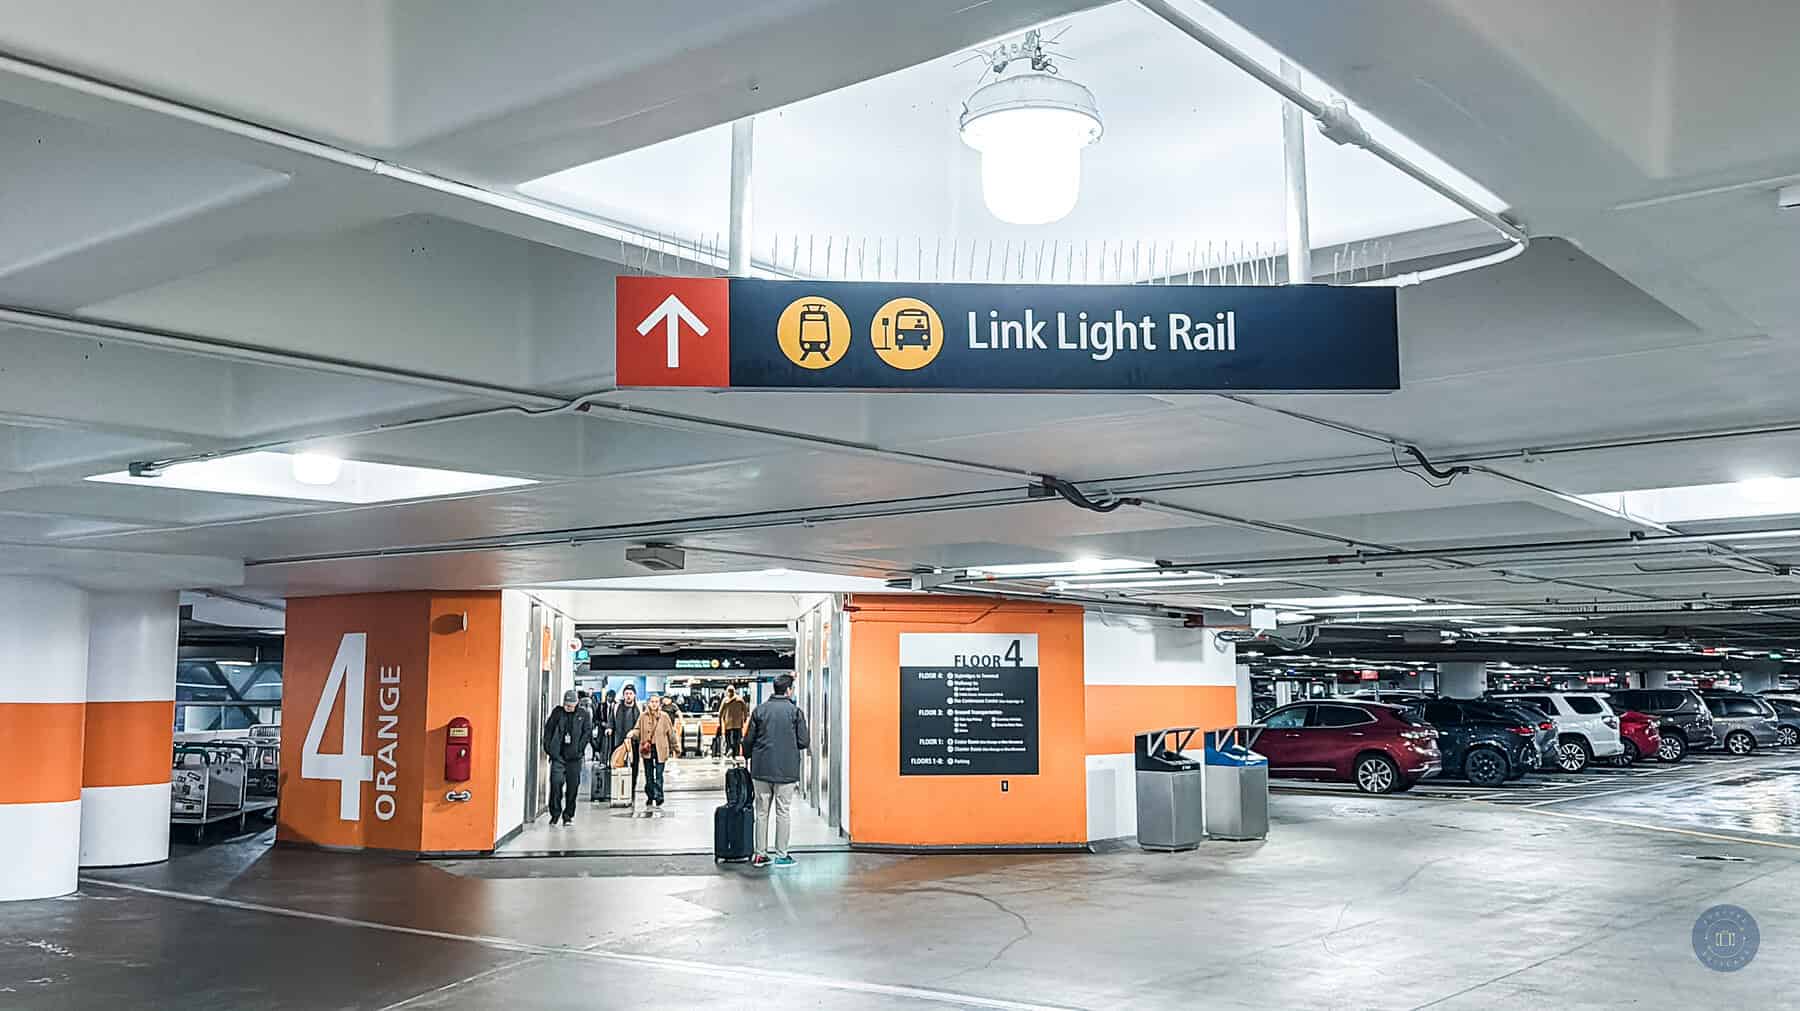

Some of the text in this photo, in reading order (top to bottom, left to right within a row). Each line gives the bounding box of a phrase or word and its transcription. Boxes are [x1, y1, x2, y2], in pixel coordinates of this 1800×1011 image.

[968, 309, 1236, 361] Link Light Rail
[954, 639, 1023, 667] FLOOR 4
[301, 632, 374, 821] 4
[375, 665, 401, 821] ORANGE
